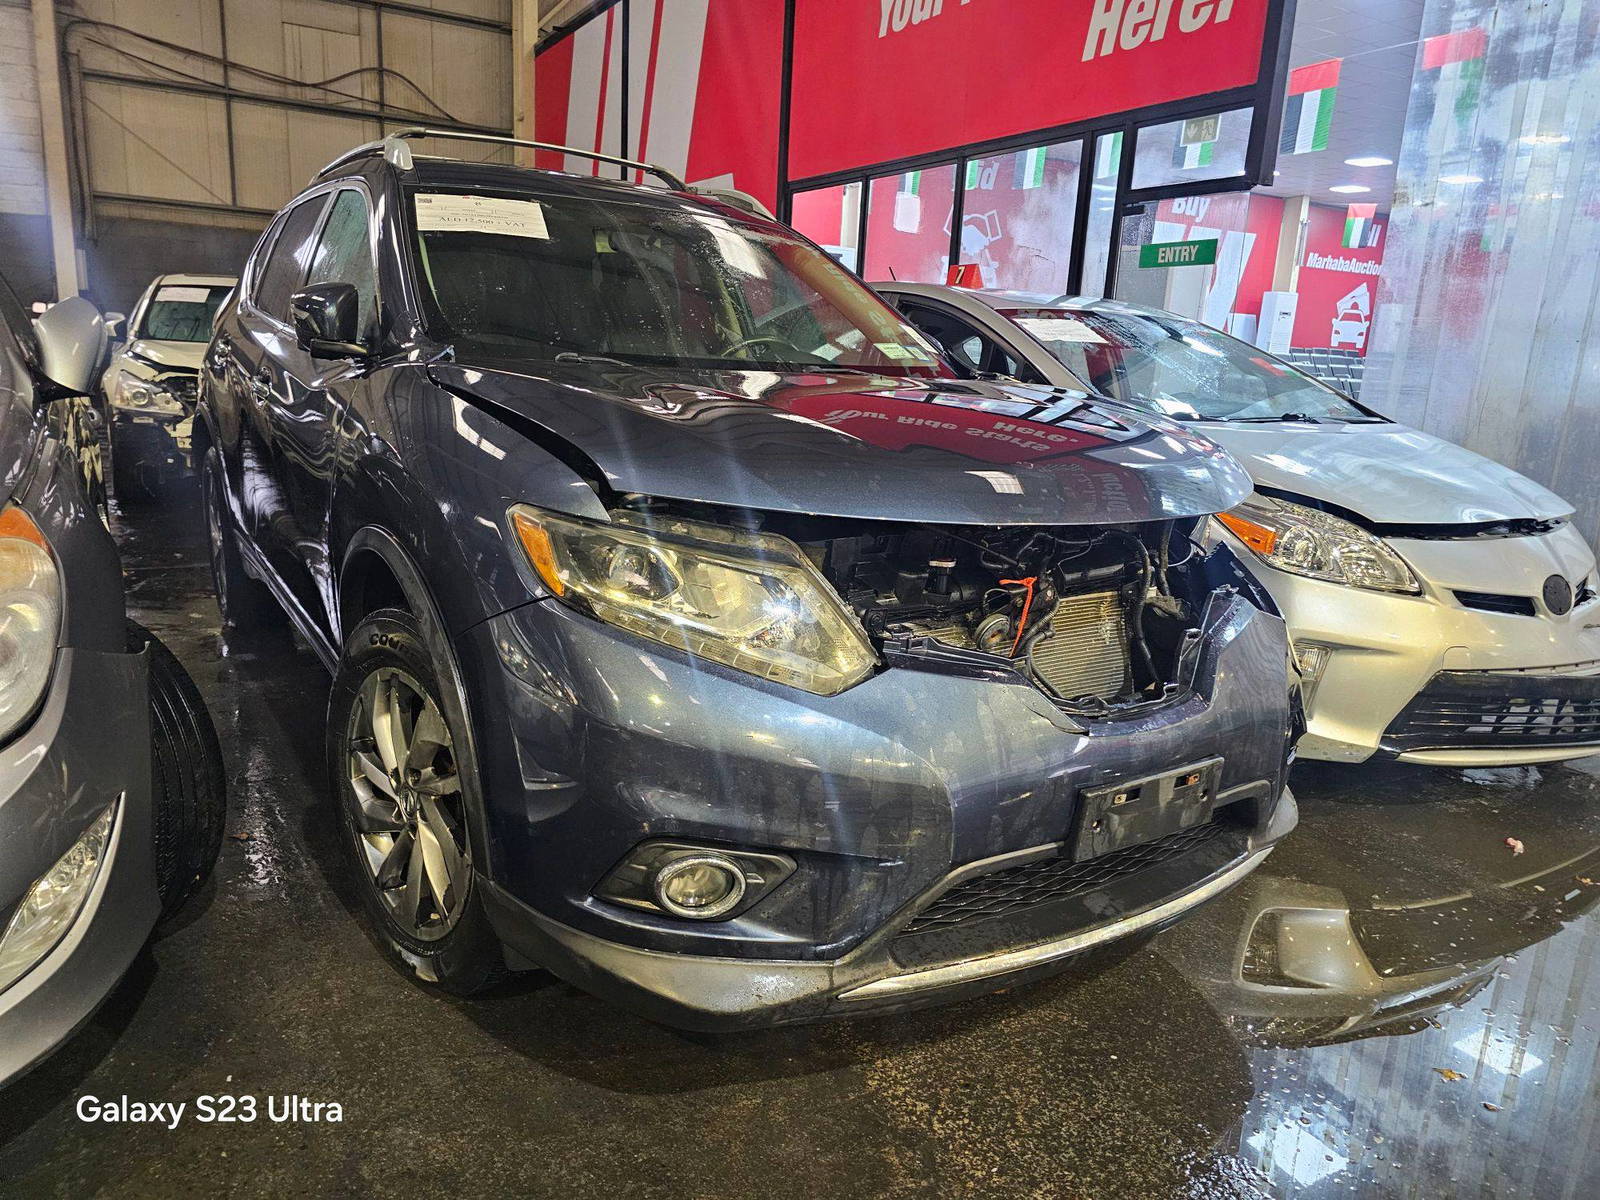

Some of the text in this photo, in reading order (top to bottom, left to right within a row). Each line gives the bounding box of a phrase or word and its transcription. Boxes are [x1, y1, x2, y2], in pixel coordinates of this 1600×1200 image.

[976, 161, 999, 190] id
[1172, 197, 1211, 223] Buy
[1158, 245, 1199, 263] ENTRY
